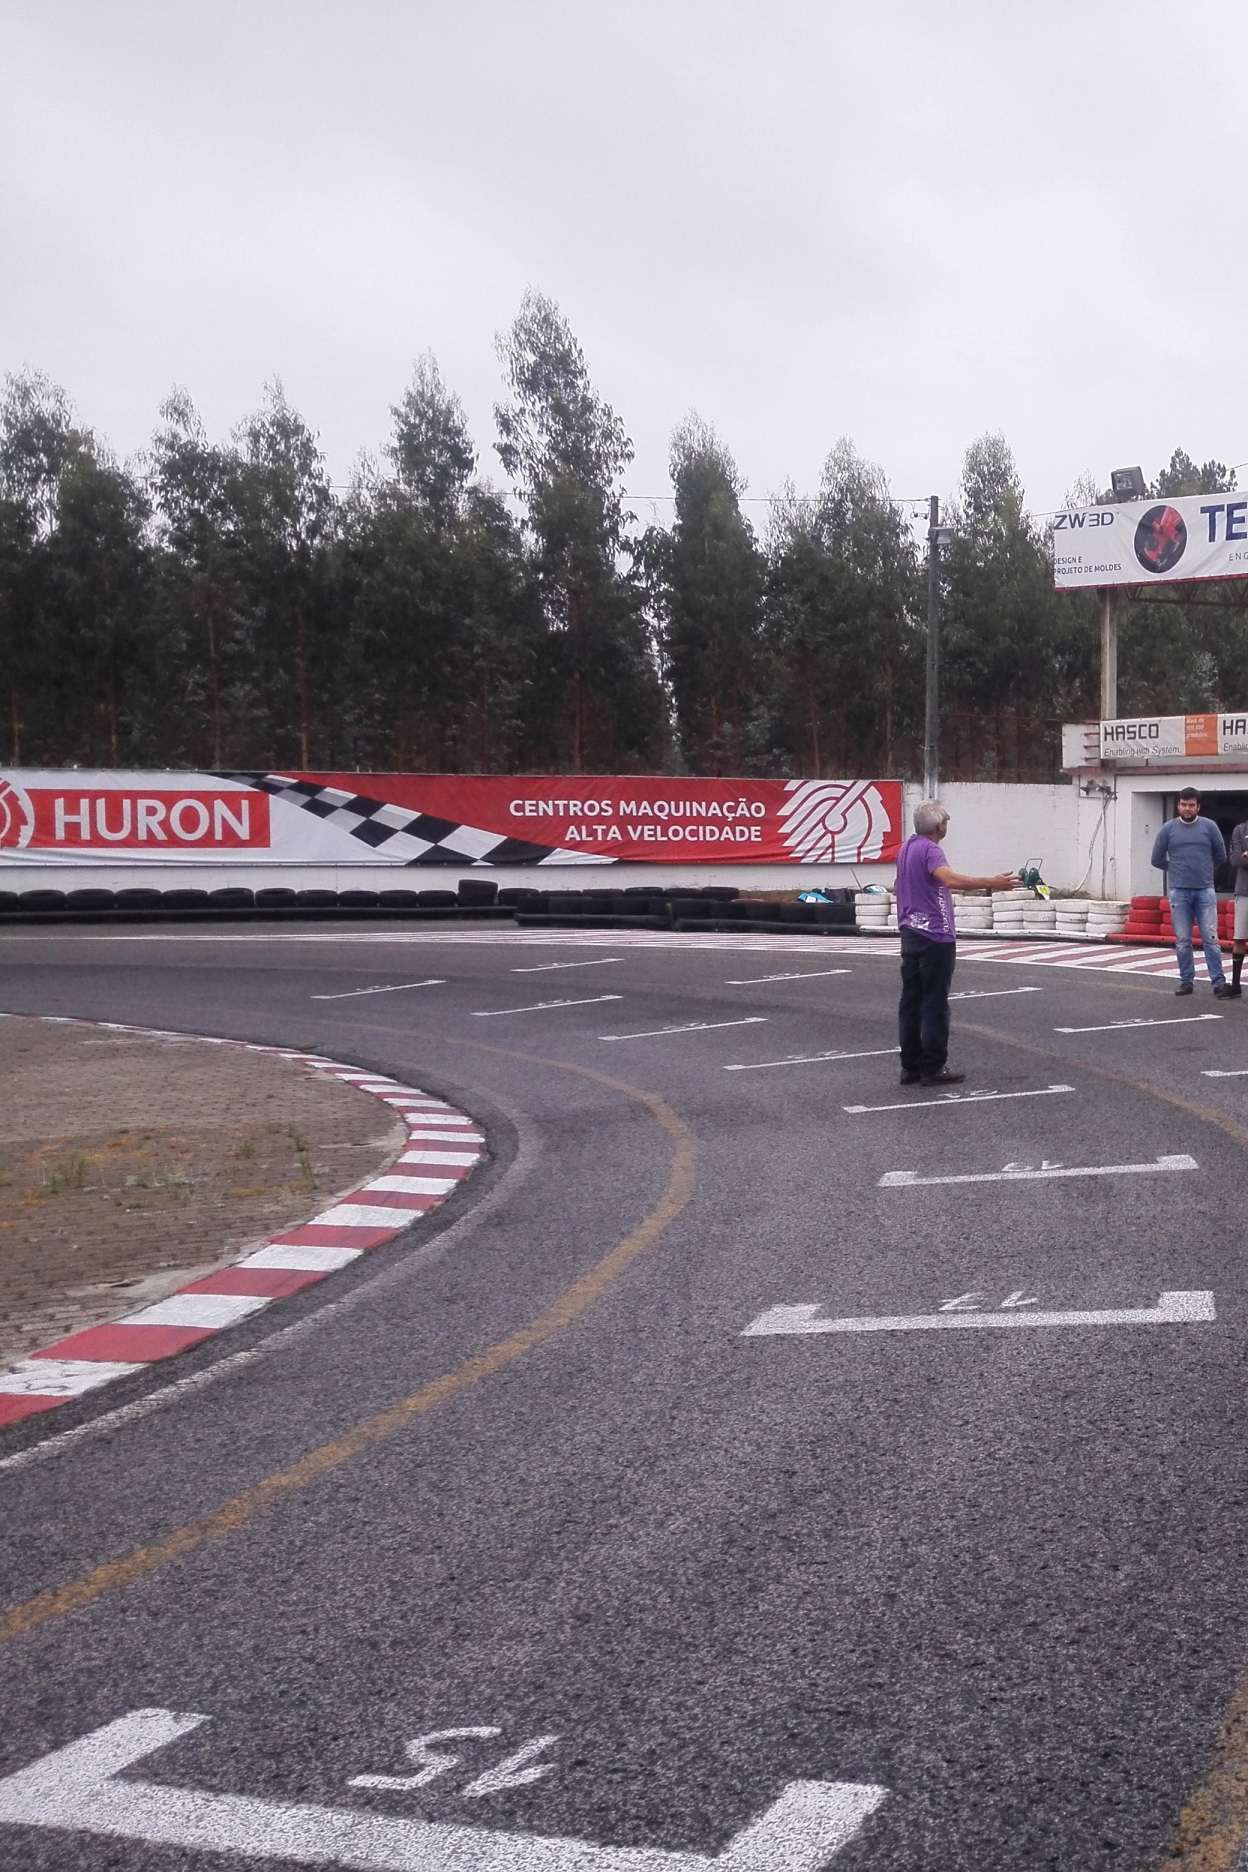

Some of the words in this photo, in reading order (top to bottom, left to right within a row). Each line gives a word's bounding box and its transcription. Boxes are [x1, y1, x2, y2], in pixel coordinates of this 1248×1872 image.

[1094, 563, 1122, 572] MOLDES
[1104, 723, 1159, 742] HASCO
[509, 799, 613, 817] CENTROS
[619, 797, 766, 822] MAQUINAÇÃO
[54, 797, 250, 842] HURON
[564, 825, 622, 841] ALTA
[627, 825, 763, 842] VELOCIDADE
